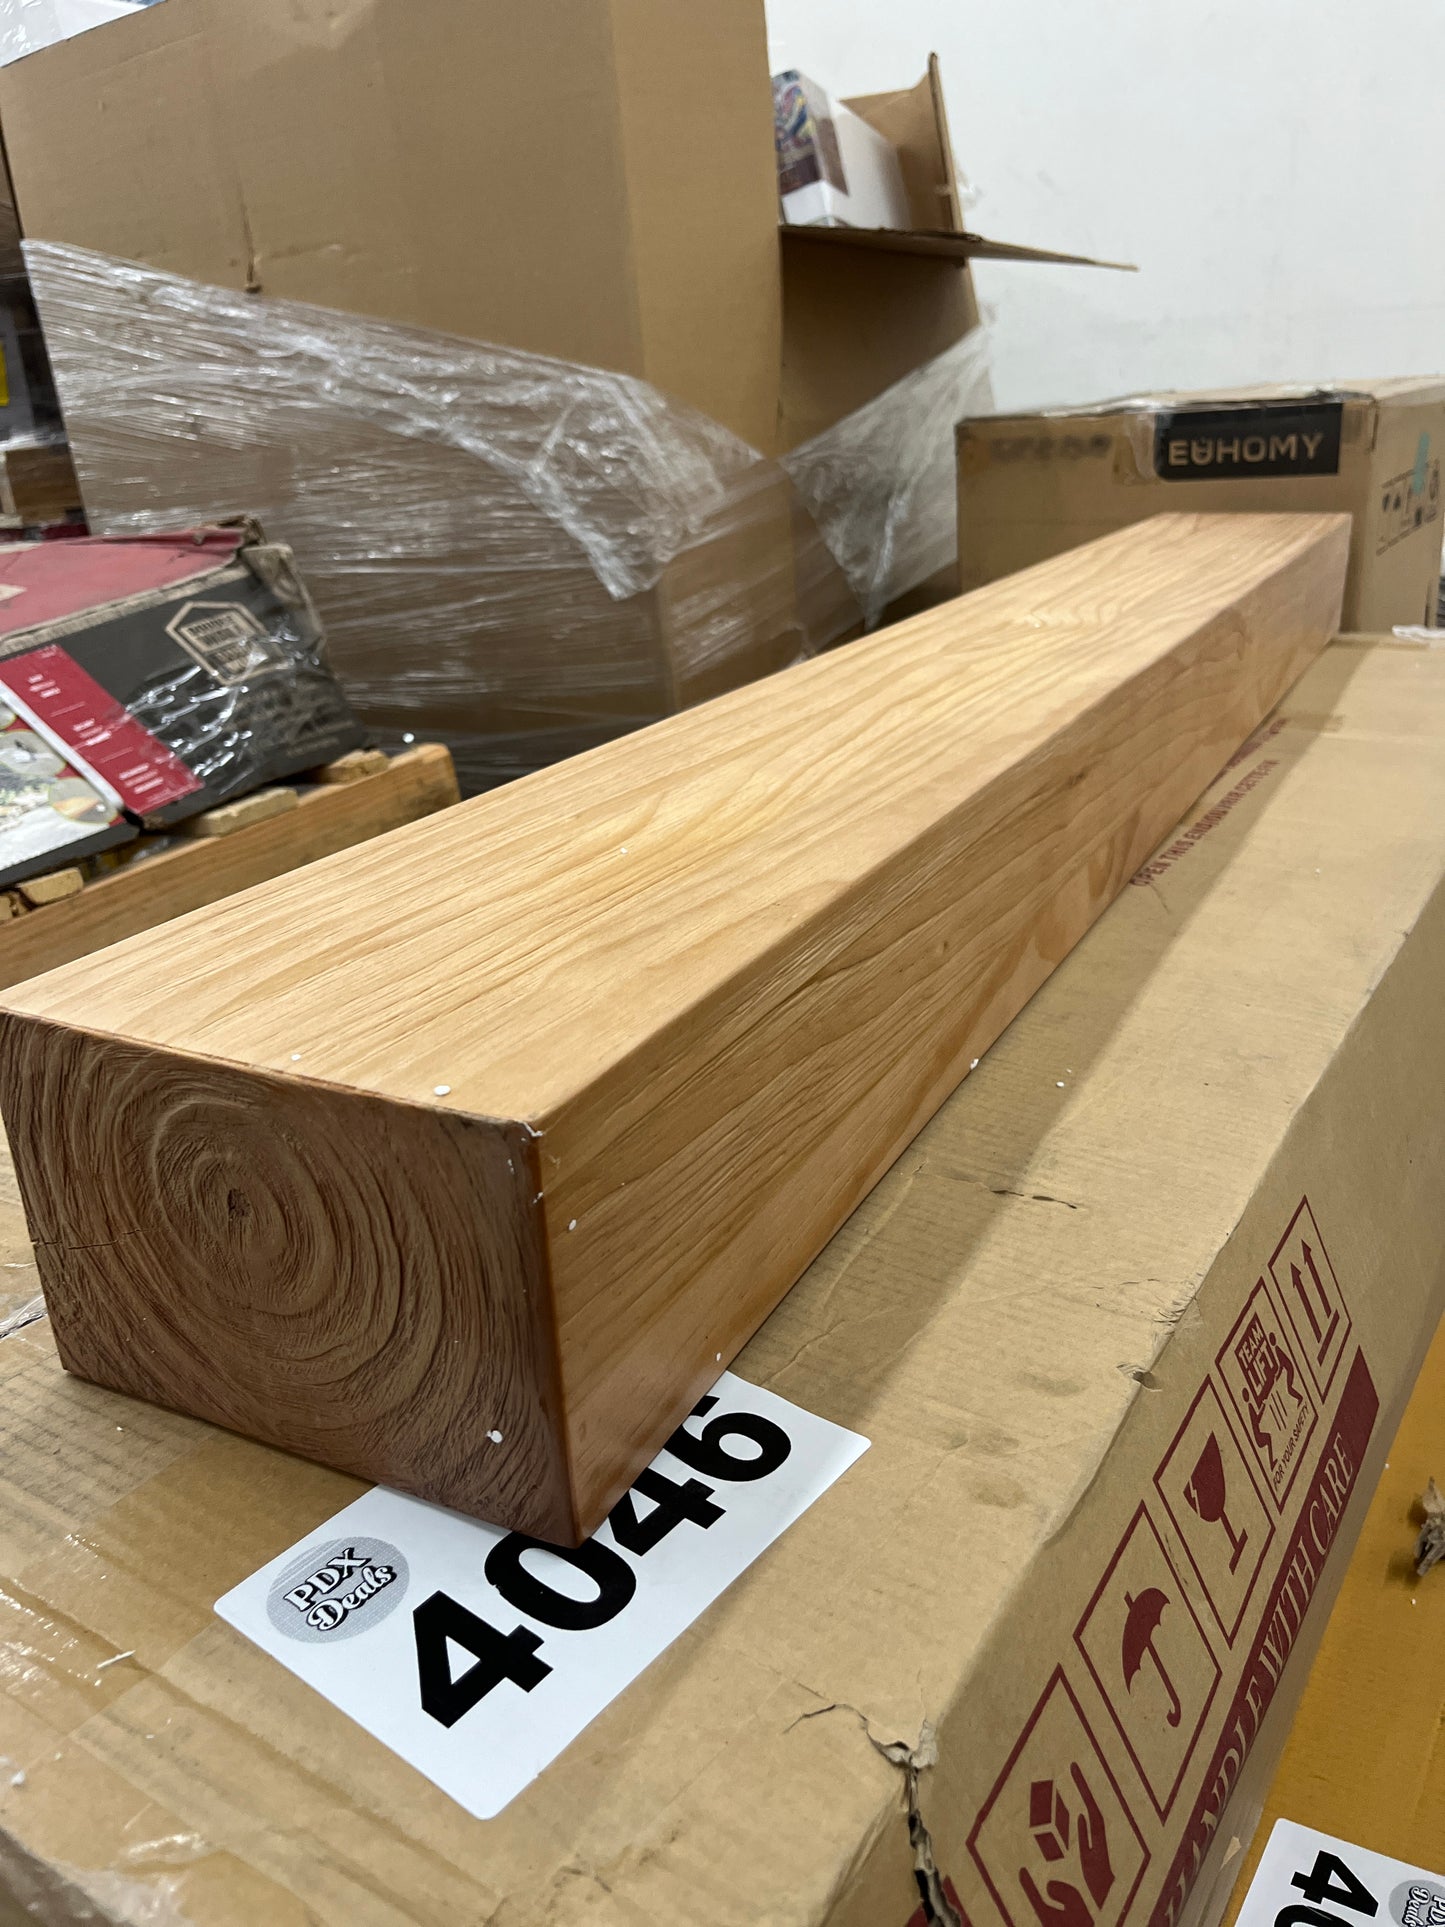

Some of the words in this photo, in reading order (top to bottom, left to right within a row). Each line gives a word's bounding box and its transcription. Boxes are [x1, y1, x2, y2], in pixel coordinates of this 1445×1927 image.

[1168, 432, 1325, 467] EUHOMY
[1238, 1319, 1264, 1369] TEAM
[1247, 1339, 1275, 1397] LIFT
[1272, 1465, 1285, 1492] FOR
[1281, 1438, 1296, 1468] YOUR
[1292, 1403, 1310, 1440] SAFETY
[283, 1547, 372, 1612] PDX
[412, 1395, 792, 1728] 4046
[1258, 1535, 1317, 1681] WITH
[1308, 1431, 1354, 1557] CARE
[306, 1565, 398, 1631] Deals
